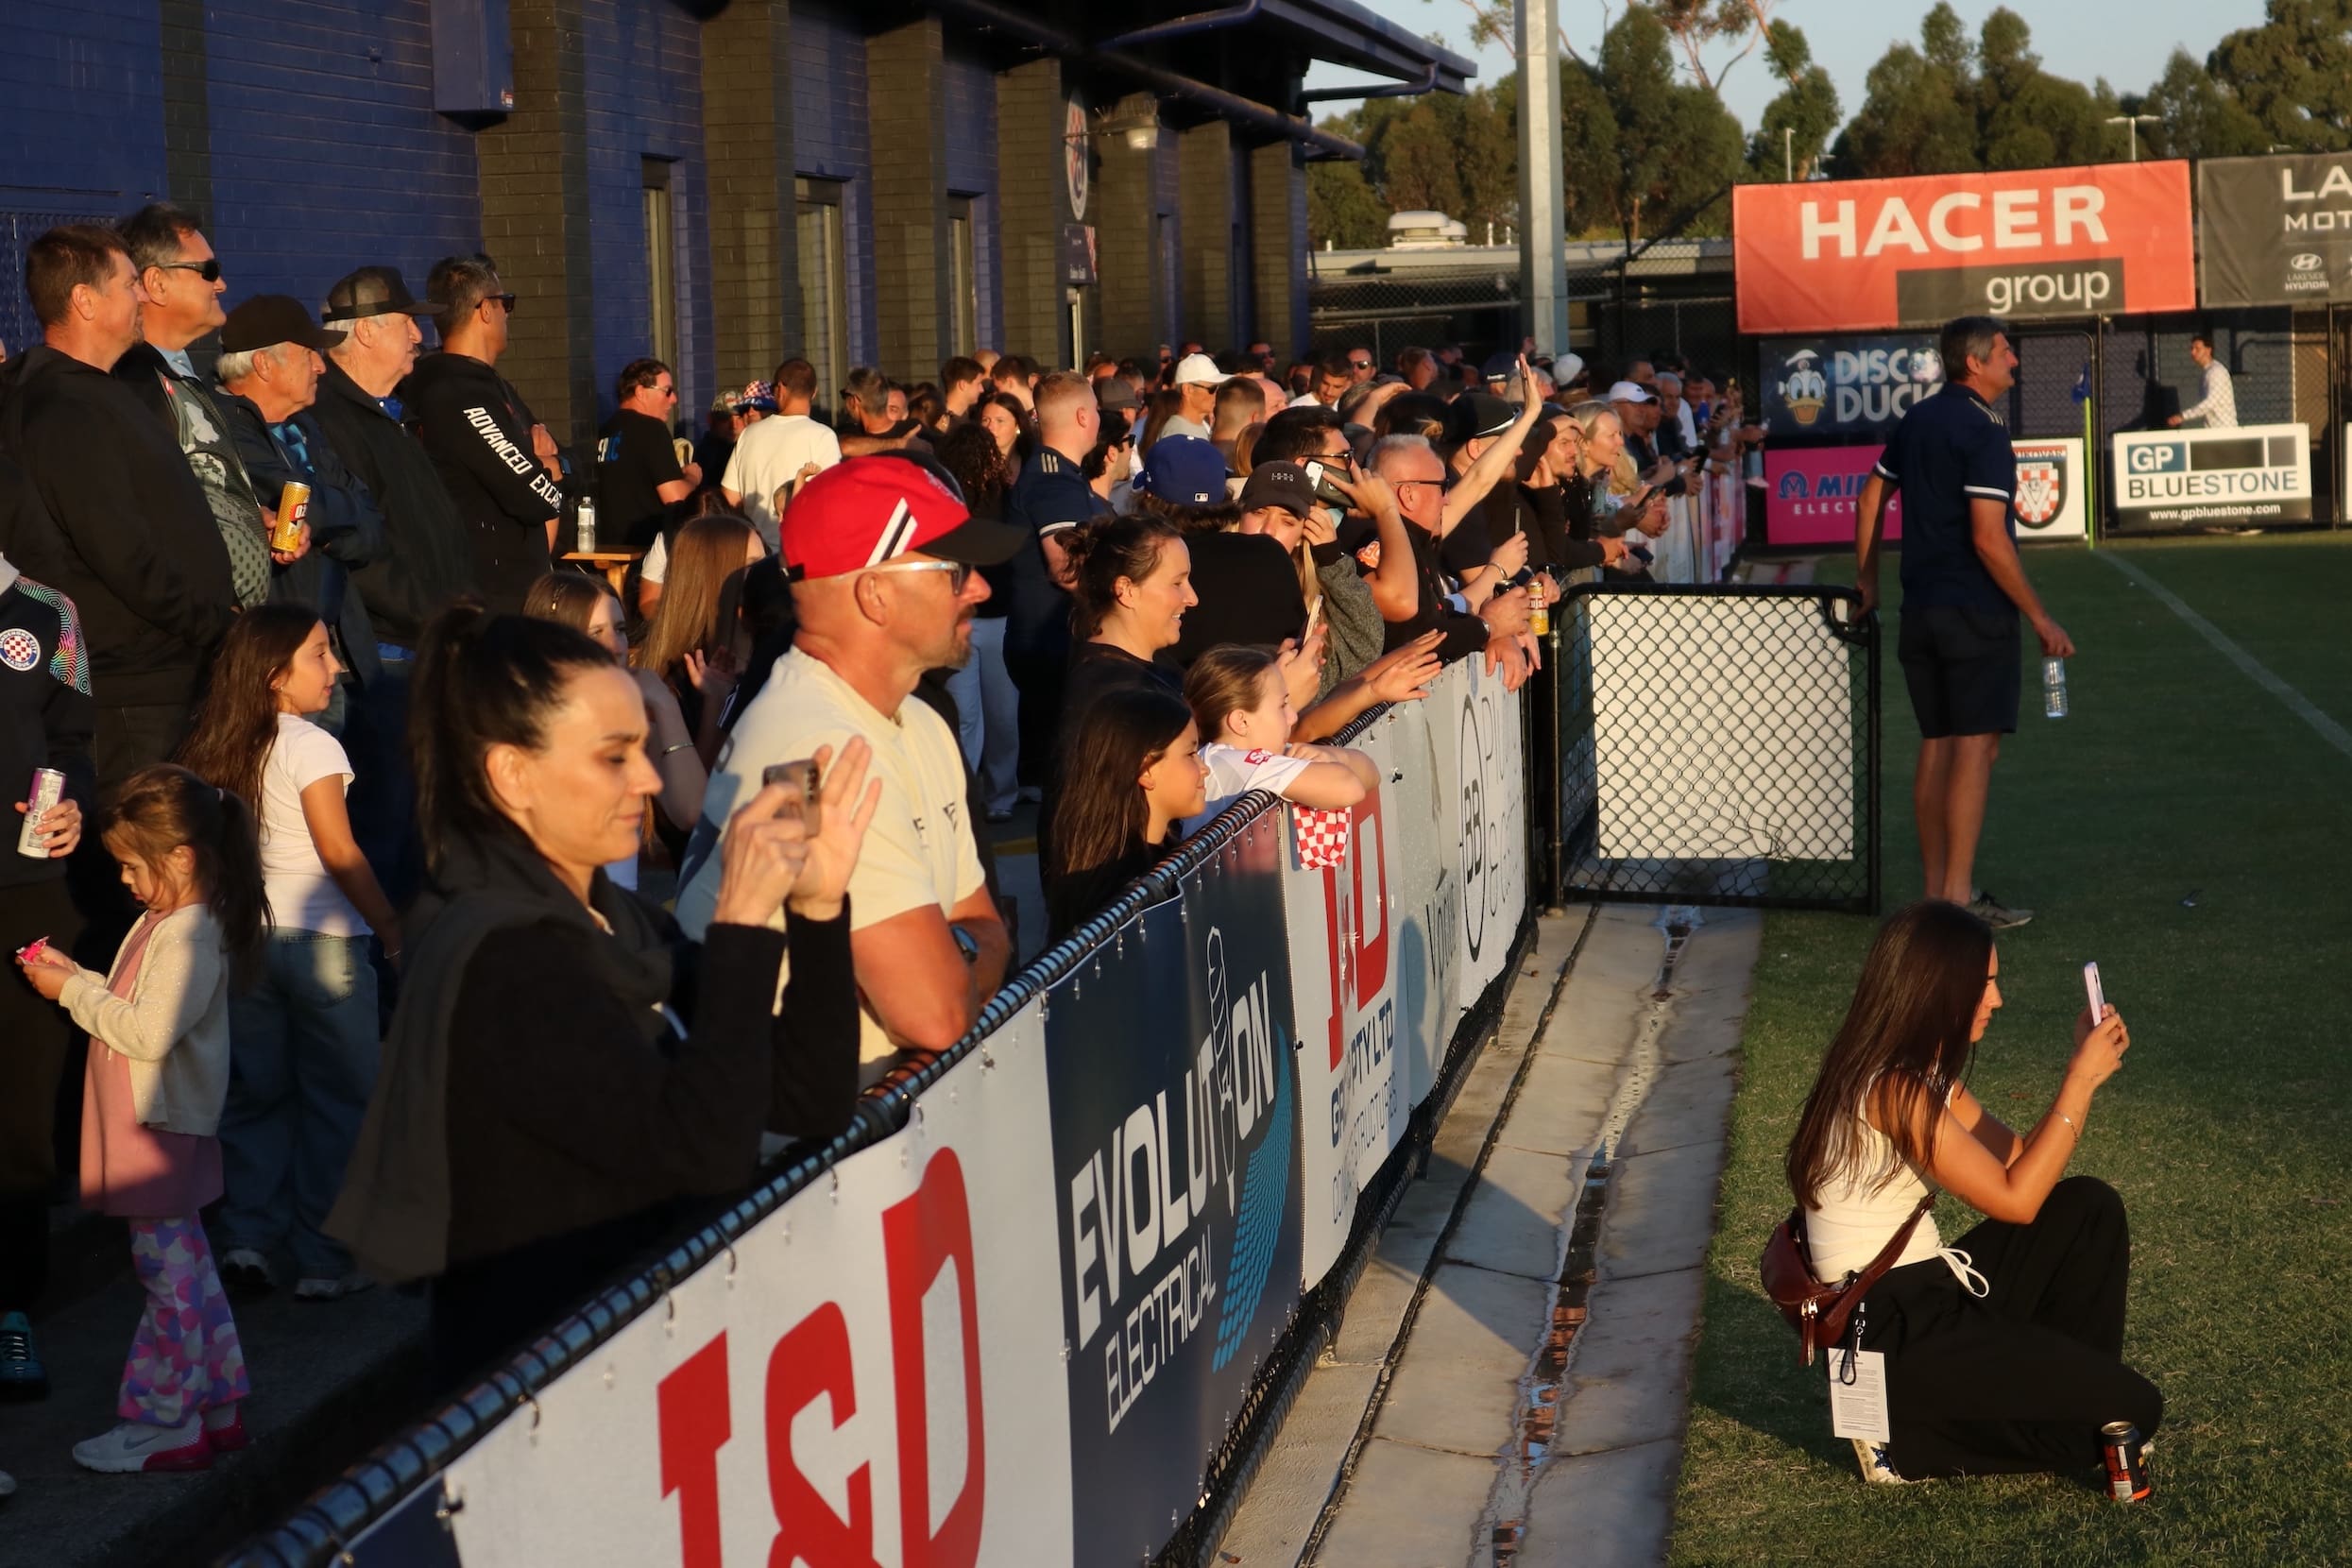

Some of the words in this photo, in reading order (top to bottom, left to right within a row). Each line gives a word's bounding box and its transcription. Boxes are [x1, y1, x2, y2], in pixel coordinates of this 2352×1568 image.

[1799, 184, 2110, 261] HACER
[1986, 269, 2111, 315] group
[463, 406, 534, 475] ADVANCED
[2131, 445, 2174, 472] GP
[1794, 500, 1898, 515] ELECTC
[2128, 470, 2299, 500] BLUESTONE
[2149, 503, 2281, 520] www.gpbluestone.com
[1372, 997, 1394, 1067] LTD
[1104, 1223, 1218, 1436] ELECTRICAL
